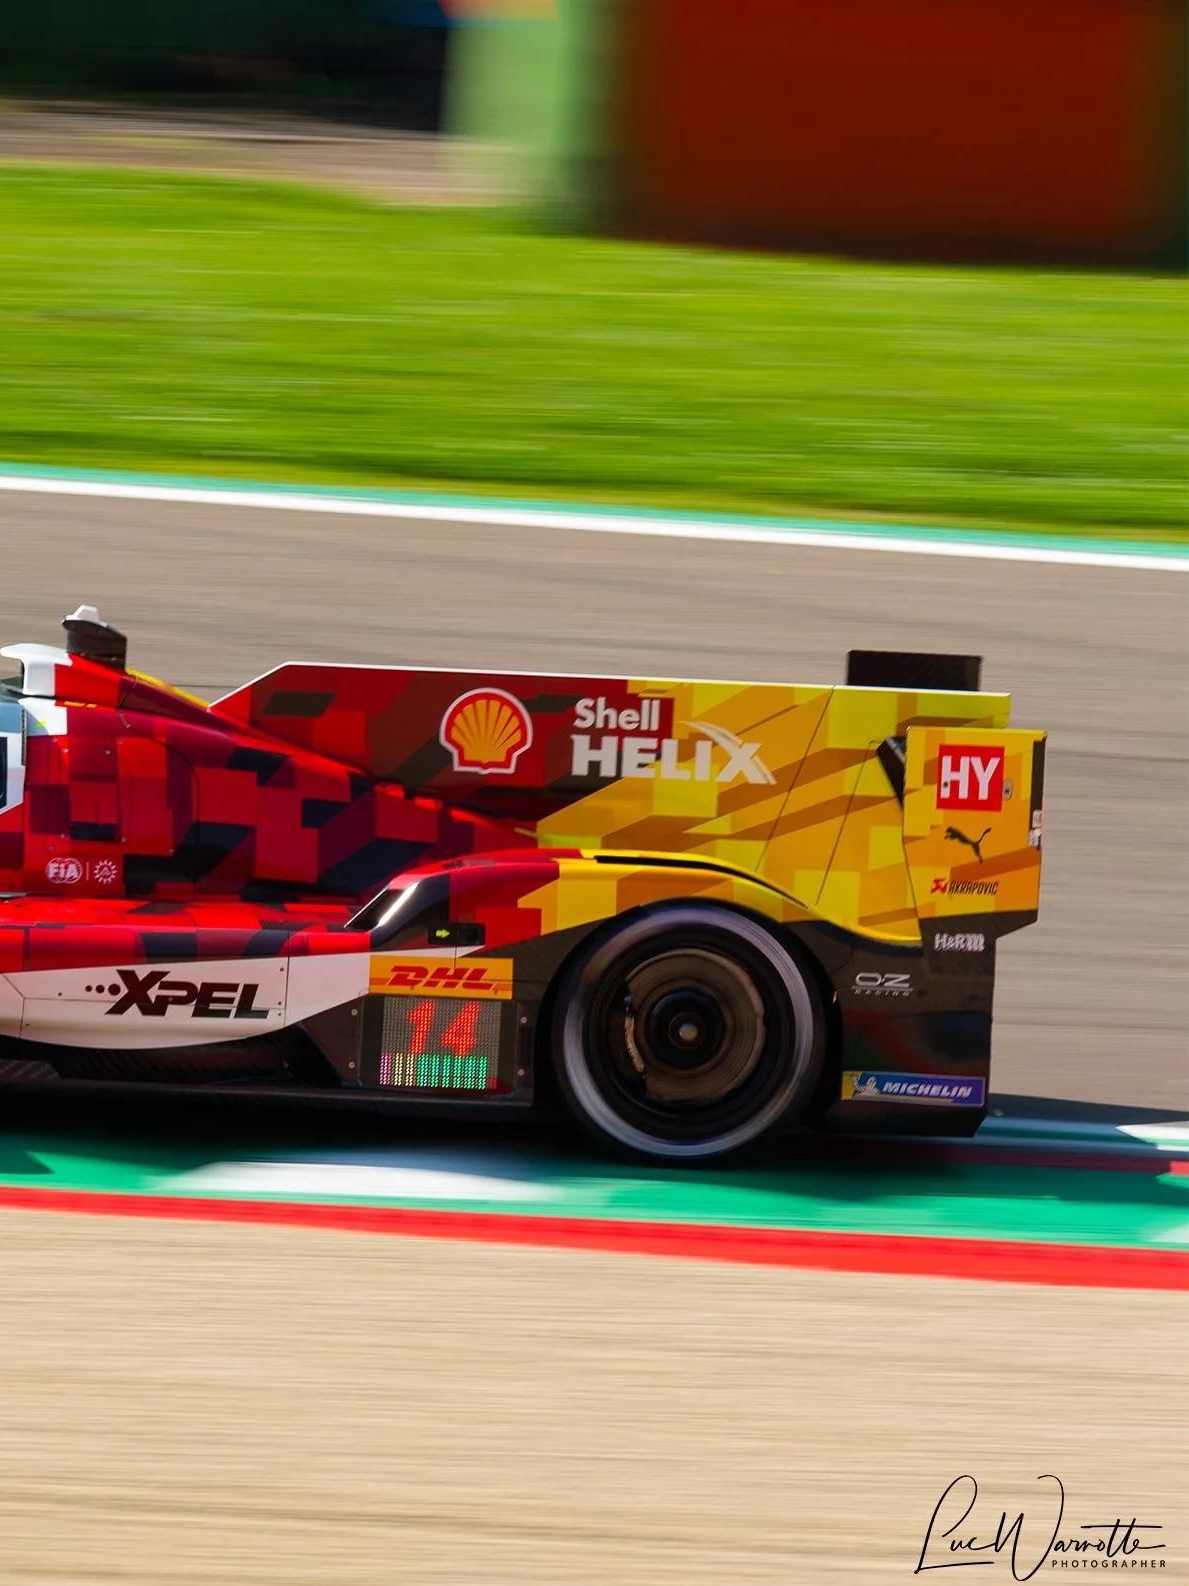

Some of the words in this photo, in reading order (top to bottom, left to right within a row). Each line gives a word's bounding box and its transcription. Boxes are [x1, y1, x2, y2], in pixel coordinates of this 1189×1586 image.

[573, 697, 661, 731] Shell
[570, 725, 775, 785] HELIX
[940, 755, 1000, 800] HY
[48, 862, 79, 879] FIA
[104, 969, 270, 1019] XPEL
[388, 965, 494, 991] DHL
[406, 1000, 481, 1056] 14
[881, 1081, 973, 1098] MICHELIN
